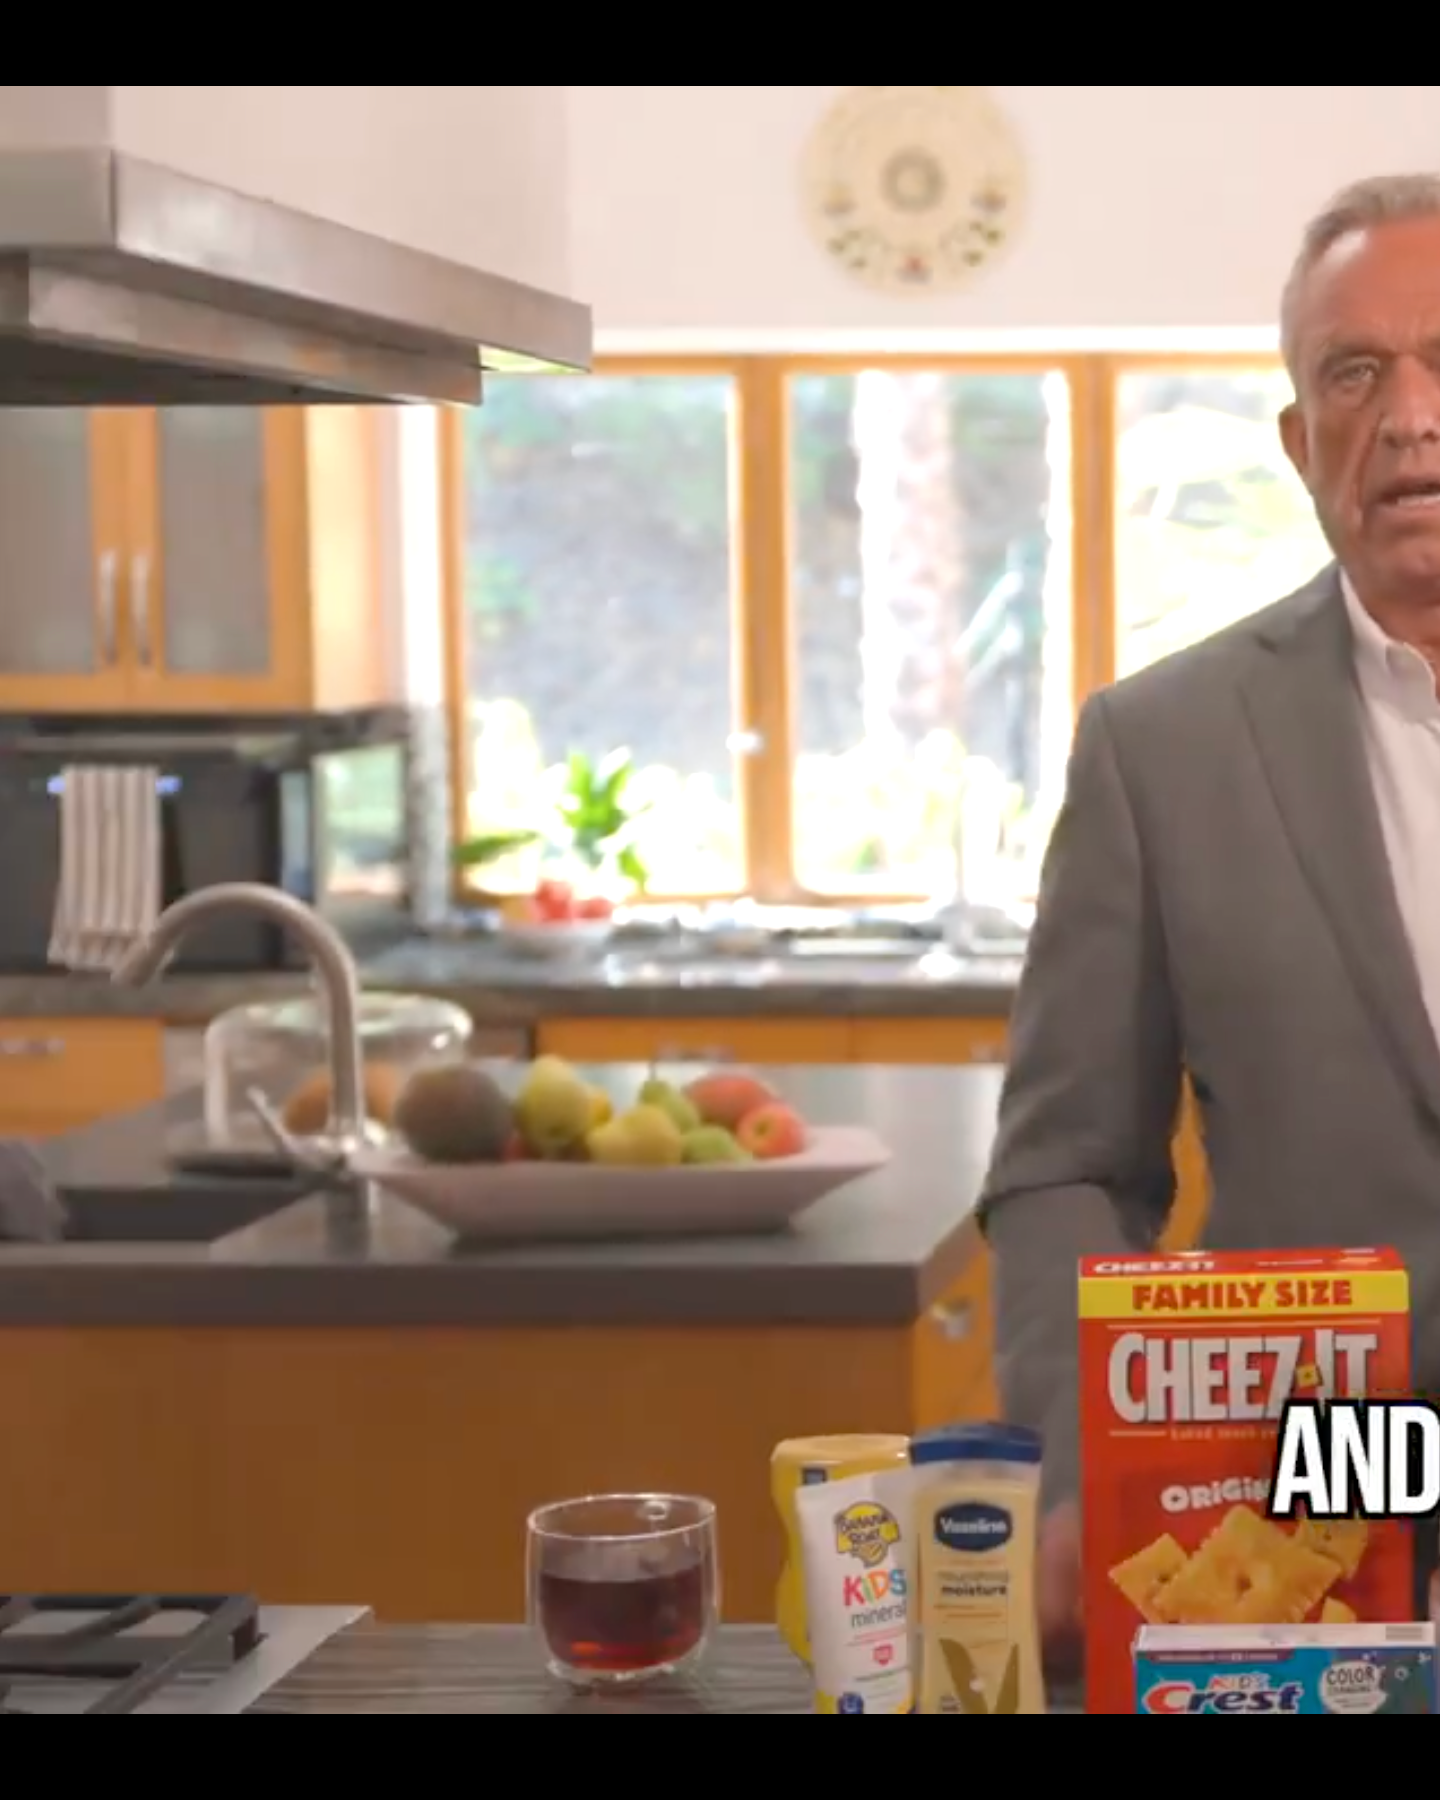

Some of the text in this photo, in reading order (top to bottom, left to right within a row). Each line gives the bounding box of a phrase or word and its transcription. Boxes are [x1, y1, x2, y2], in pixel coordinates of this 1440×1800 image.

[1132, 1279, 1352, 1310] FAMILY SIZE
[1327, 1666, 1376, 1685] COLOR
[1145, 1682, 1300, 1714] Crest
